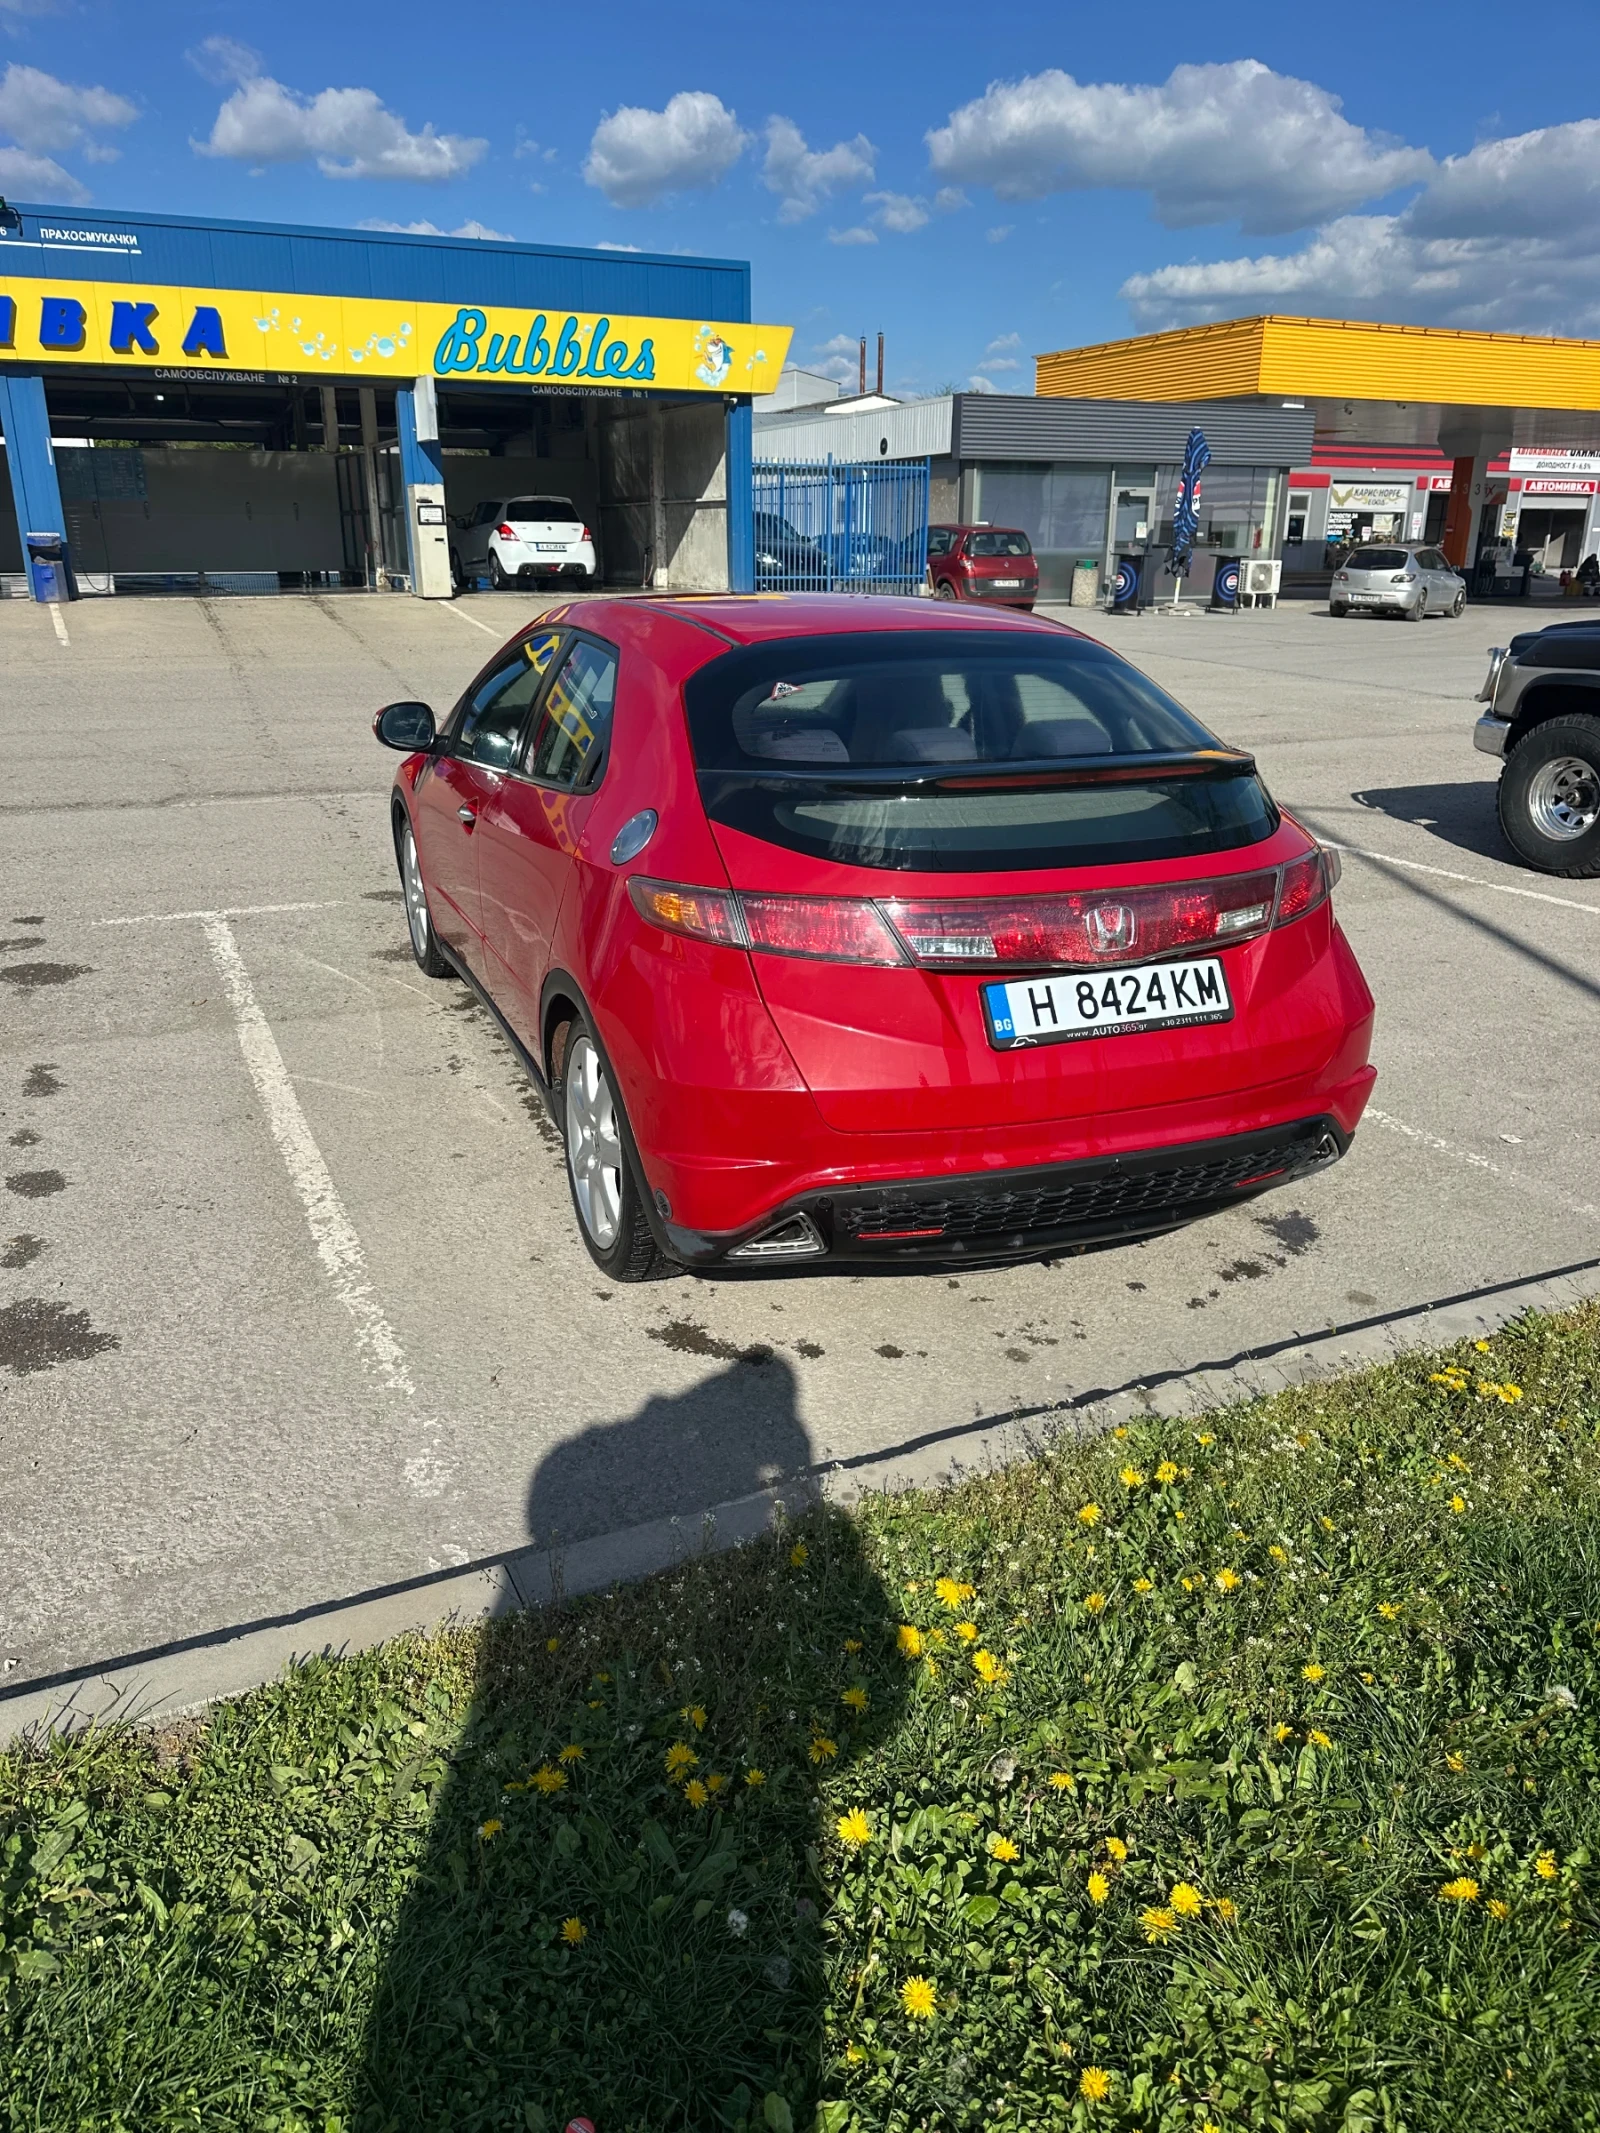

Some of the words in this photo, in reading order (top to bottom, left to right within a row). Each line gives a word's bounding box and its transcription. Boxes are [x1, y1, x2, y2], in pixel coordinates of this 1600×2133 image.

[40, 228, 138, 246] ПРАХОСМУКАЧКИ
[433, 308, 656, 381] Bubbles
[154, 367, 266, 384] САМООБСЛУЖВАНЕ
[531, 384, 623, 398] САМООБСЛУЖВАНЕ
[1436, 479, 1452, 489] АВ
[1474, 483, 1481, 495] 3
[1528, 481, 1591, 492] АВТОМИВКА
[1504, 579, 1510, 590] 3
[1028, 985, 1059, 1027] H
[994, 1019, 1013, 1032] BG
[1161, 1019, 1175, 1027] +30
[1176, 1016, 1192, 1025] 2311
[1194, 1014, 1207, 1022] 111
[1210, 1012, 1223, 1020] 365
